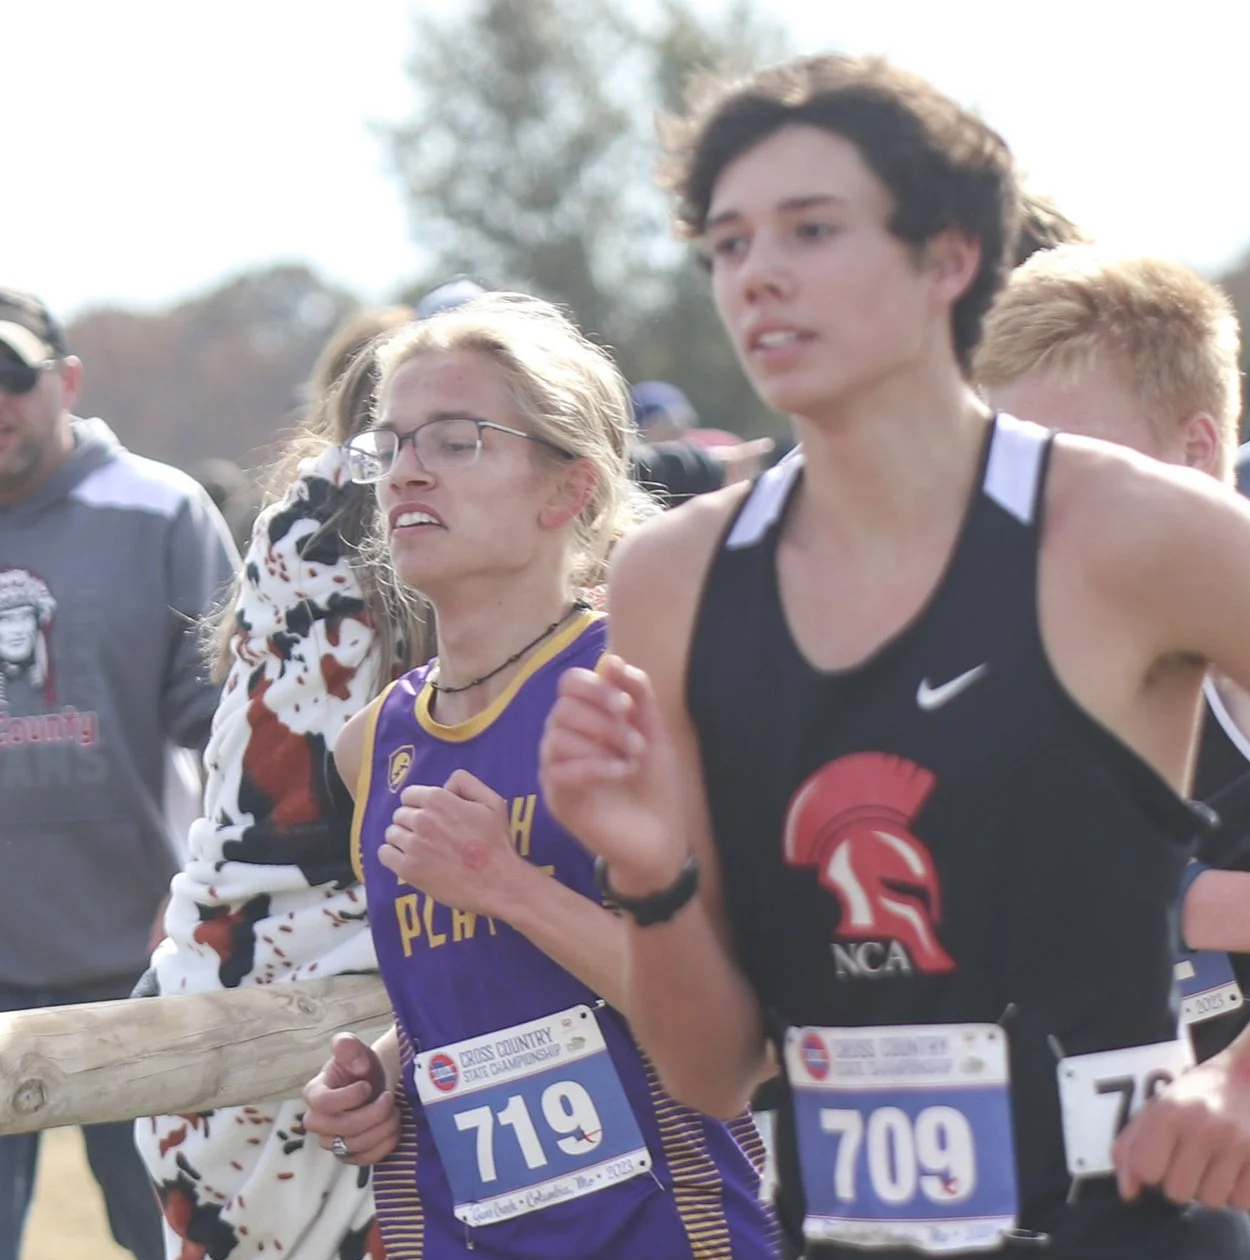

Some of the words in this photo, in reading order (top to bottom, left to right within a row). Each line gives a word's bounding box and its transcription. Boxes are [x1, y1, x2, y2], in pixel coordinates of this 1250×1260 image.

[832, 939, 912, 975] NCA
[1195, 992, 1225, 1014] 2023
[458, 1044, 496, 1069] CROSS
[495, 1026, 553, 1058] COUNTRY
[462, 1066, 490, 1083] STATE
[489, 1043, 561, 1076] CHAMPIONSHIP
[453, 1080, 603, 1183] 719
[819, 1105, 977, 1206] 709
